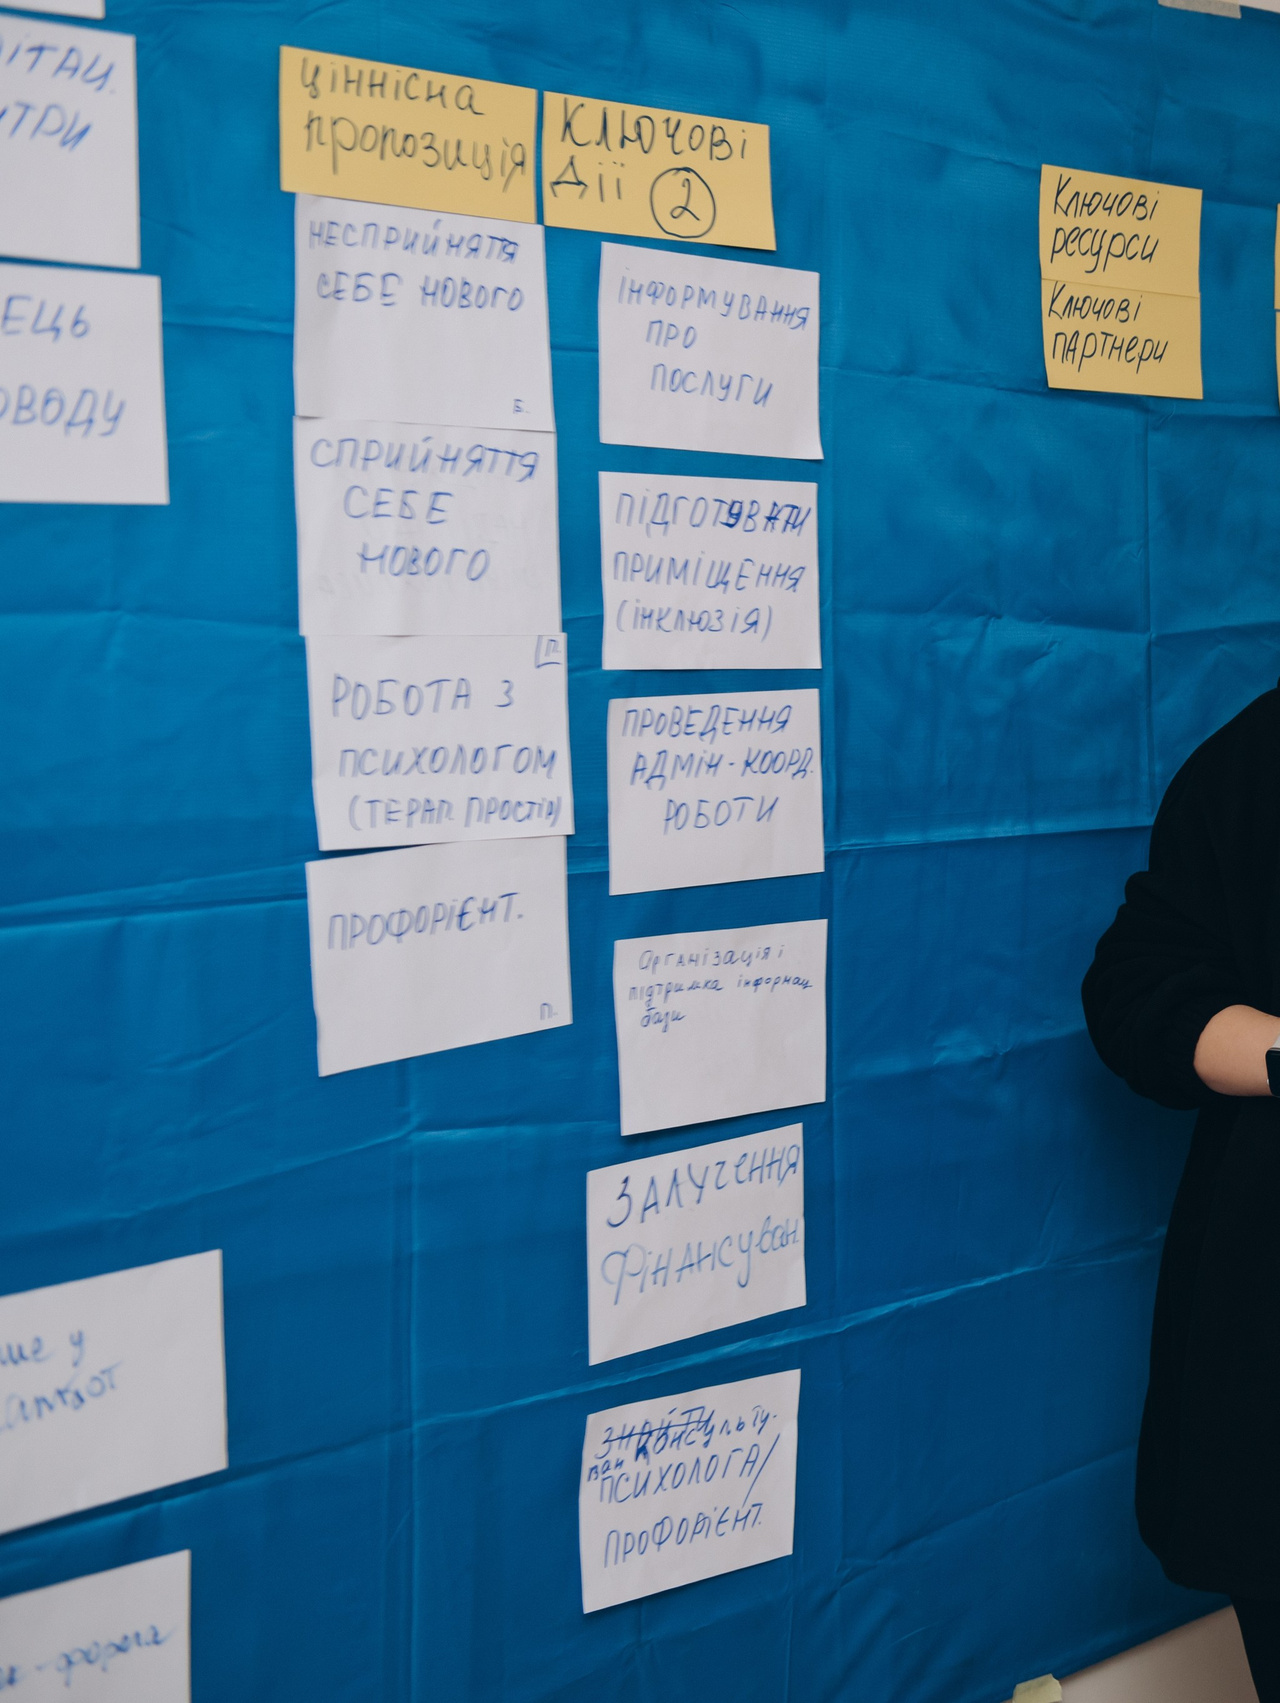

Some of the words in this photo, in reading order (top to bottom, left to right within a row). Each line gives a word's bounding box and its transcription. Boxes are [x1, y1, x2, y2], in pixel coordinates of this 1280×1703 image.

[0, 100, 94, 154] ТРИ
[315, 270, 402, 308] СЕБЕ
[418, 274, 525, 312] НОВОГО
[645, 318, 698, 350] ПРО
[650, 362, 774, 408] ПОСЛУГИ
[310, 435, 540, 483] СПРИЙНЯТТЯ
[342, 484, 454, 526] СЕБЕ
[356, 542, 490, 582] НОВОГО
[612, 550, 806, 595] ПРИМІЩЕННЯ
[331, 673, 472, 721] РОБОТА
[621, 704, 794, 744] ПРОВЕДЕННЯ
[338, 743, 558, 780] ПСИХОЛОГОМ
[662, 795, 780, 835] РОБОТИ
